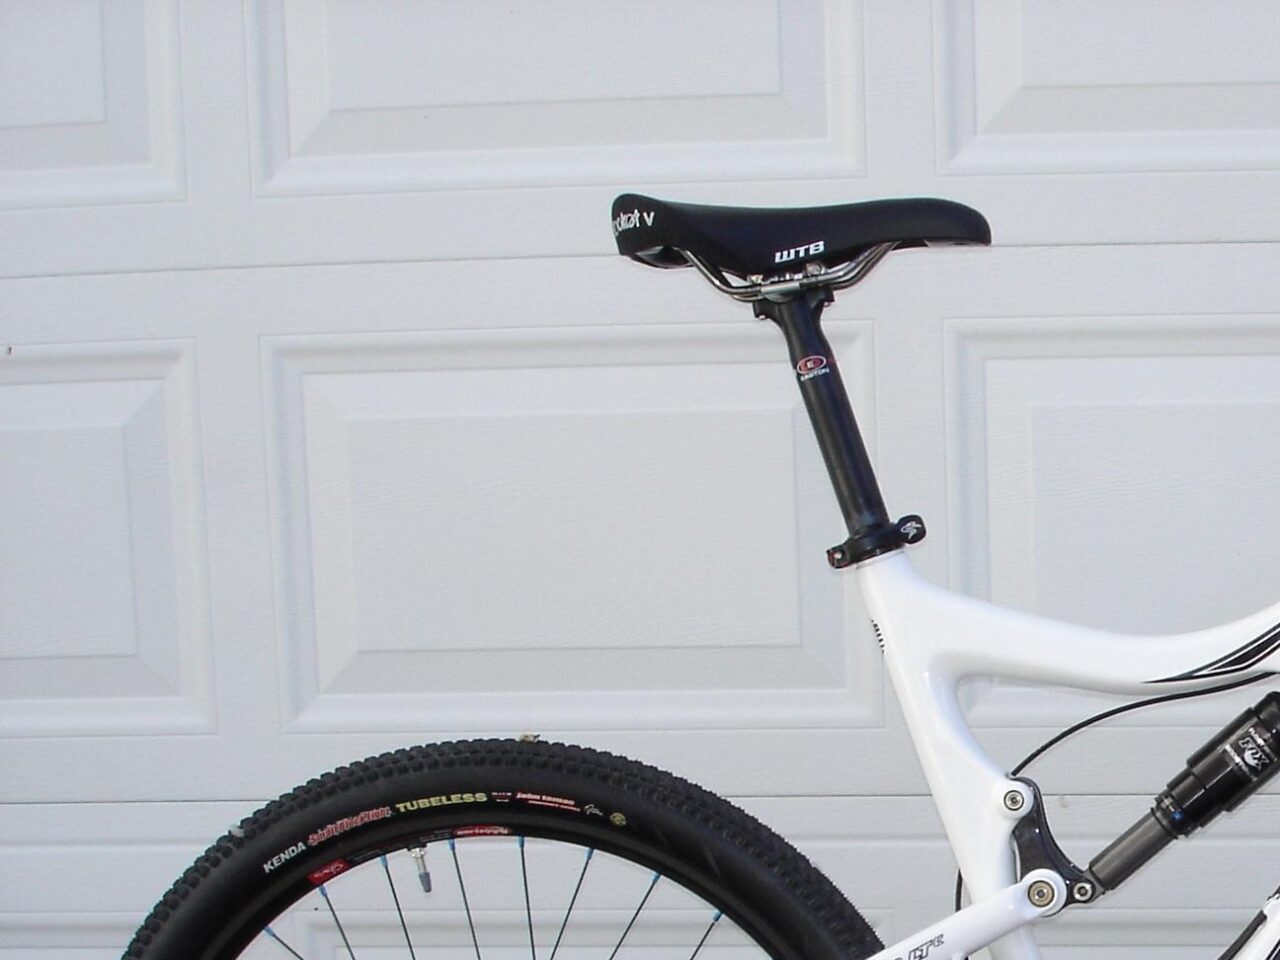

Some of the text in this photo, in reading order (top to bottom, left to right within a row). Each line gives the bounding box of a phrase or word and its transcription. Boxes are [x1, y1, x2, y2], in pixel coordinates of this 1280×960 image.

[775, 240, 824, 263] WTB
[1238, 736, 1270, 770] FOX
[263, 841, 307, 874] KENDA
[395, 792, 488, 812] TUBELESS
